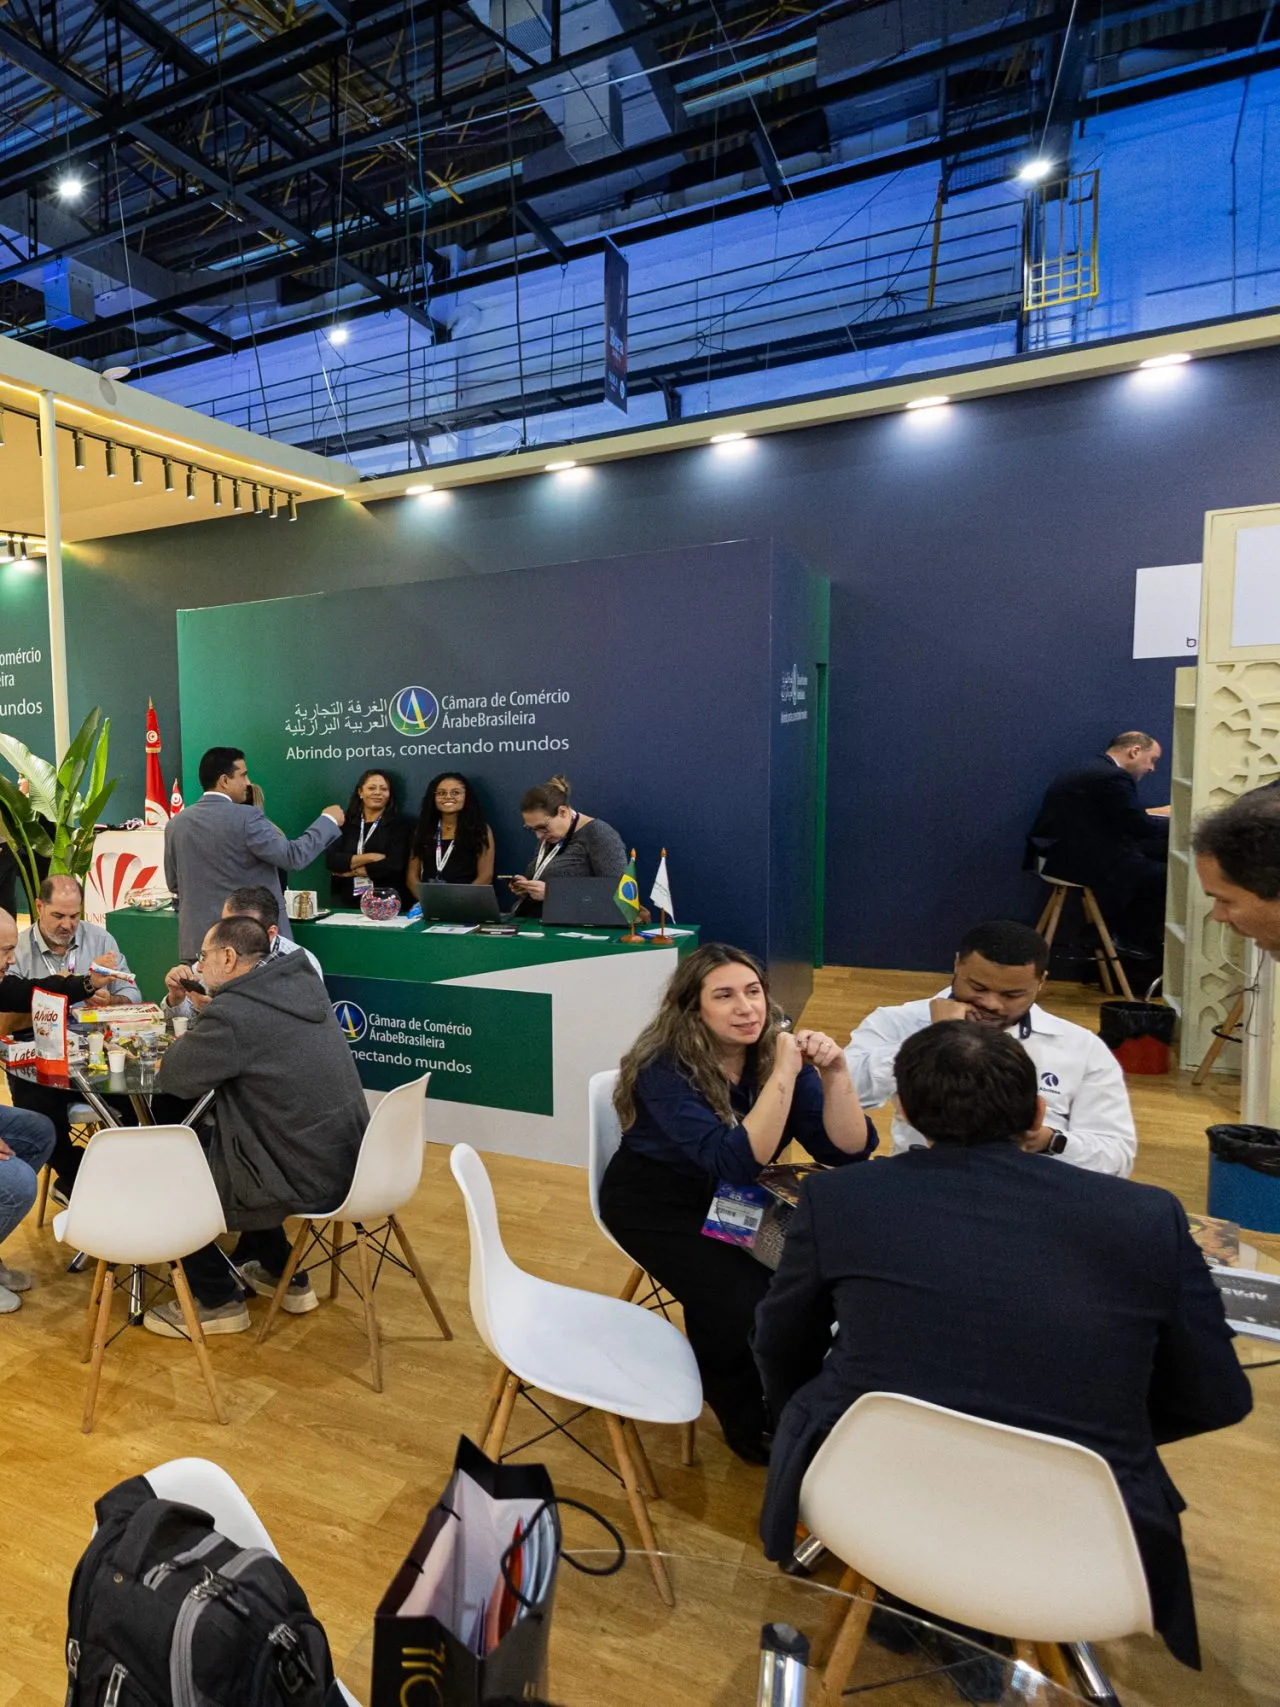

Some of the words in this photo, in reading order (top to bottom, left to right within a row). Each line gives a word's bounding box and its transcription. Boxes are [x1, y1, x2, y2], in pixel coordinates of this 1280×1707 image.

[348, 698, 387, 717] الغرفة
[441, 694, 488, 710] Câmara
[491, 692, 506, 707] de
[509, 688, 570, 706] Comércio
[295, 701, 343, 721] التجارية
[442, 710, 536, 730] ÁrabeBrasileira
[284, 717, 340, 737] البرازيلية
[344, 714, 388, 734] العربية
[286, 746, 342, 761] Abrindo
[345, 744, 395, 761] portas,
[399, 738, 494, 757] conectando
[499, 735, 570, 752] mundos
[369, 1012, 407, 1030] Câmara
[408, 1017, 422, 1031] de
[423, 1018, 473, 1037] Comércio
[369, 1026, 446, 1049] ÁrabeBrasileira
[350, 1049, 412, 1066] nectando
[415, 1057, 473, 1075] mundos
